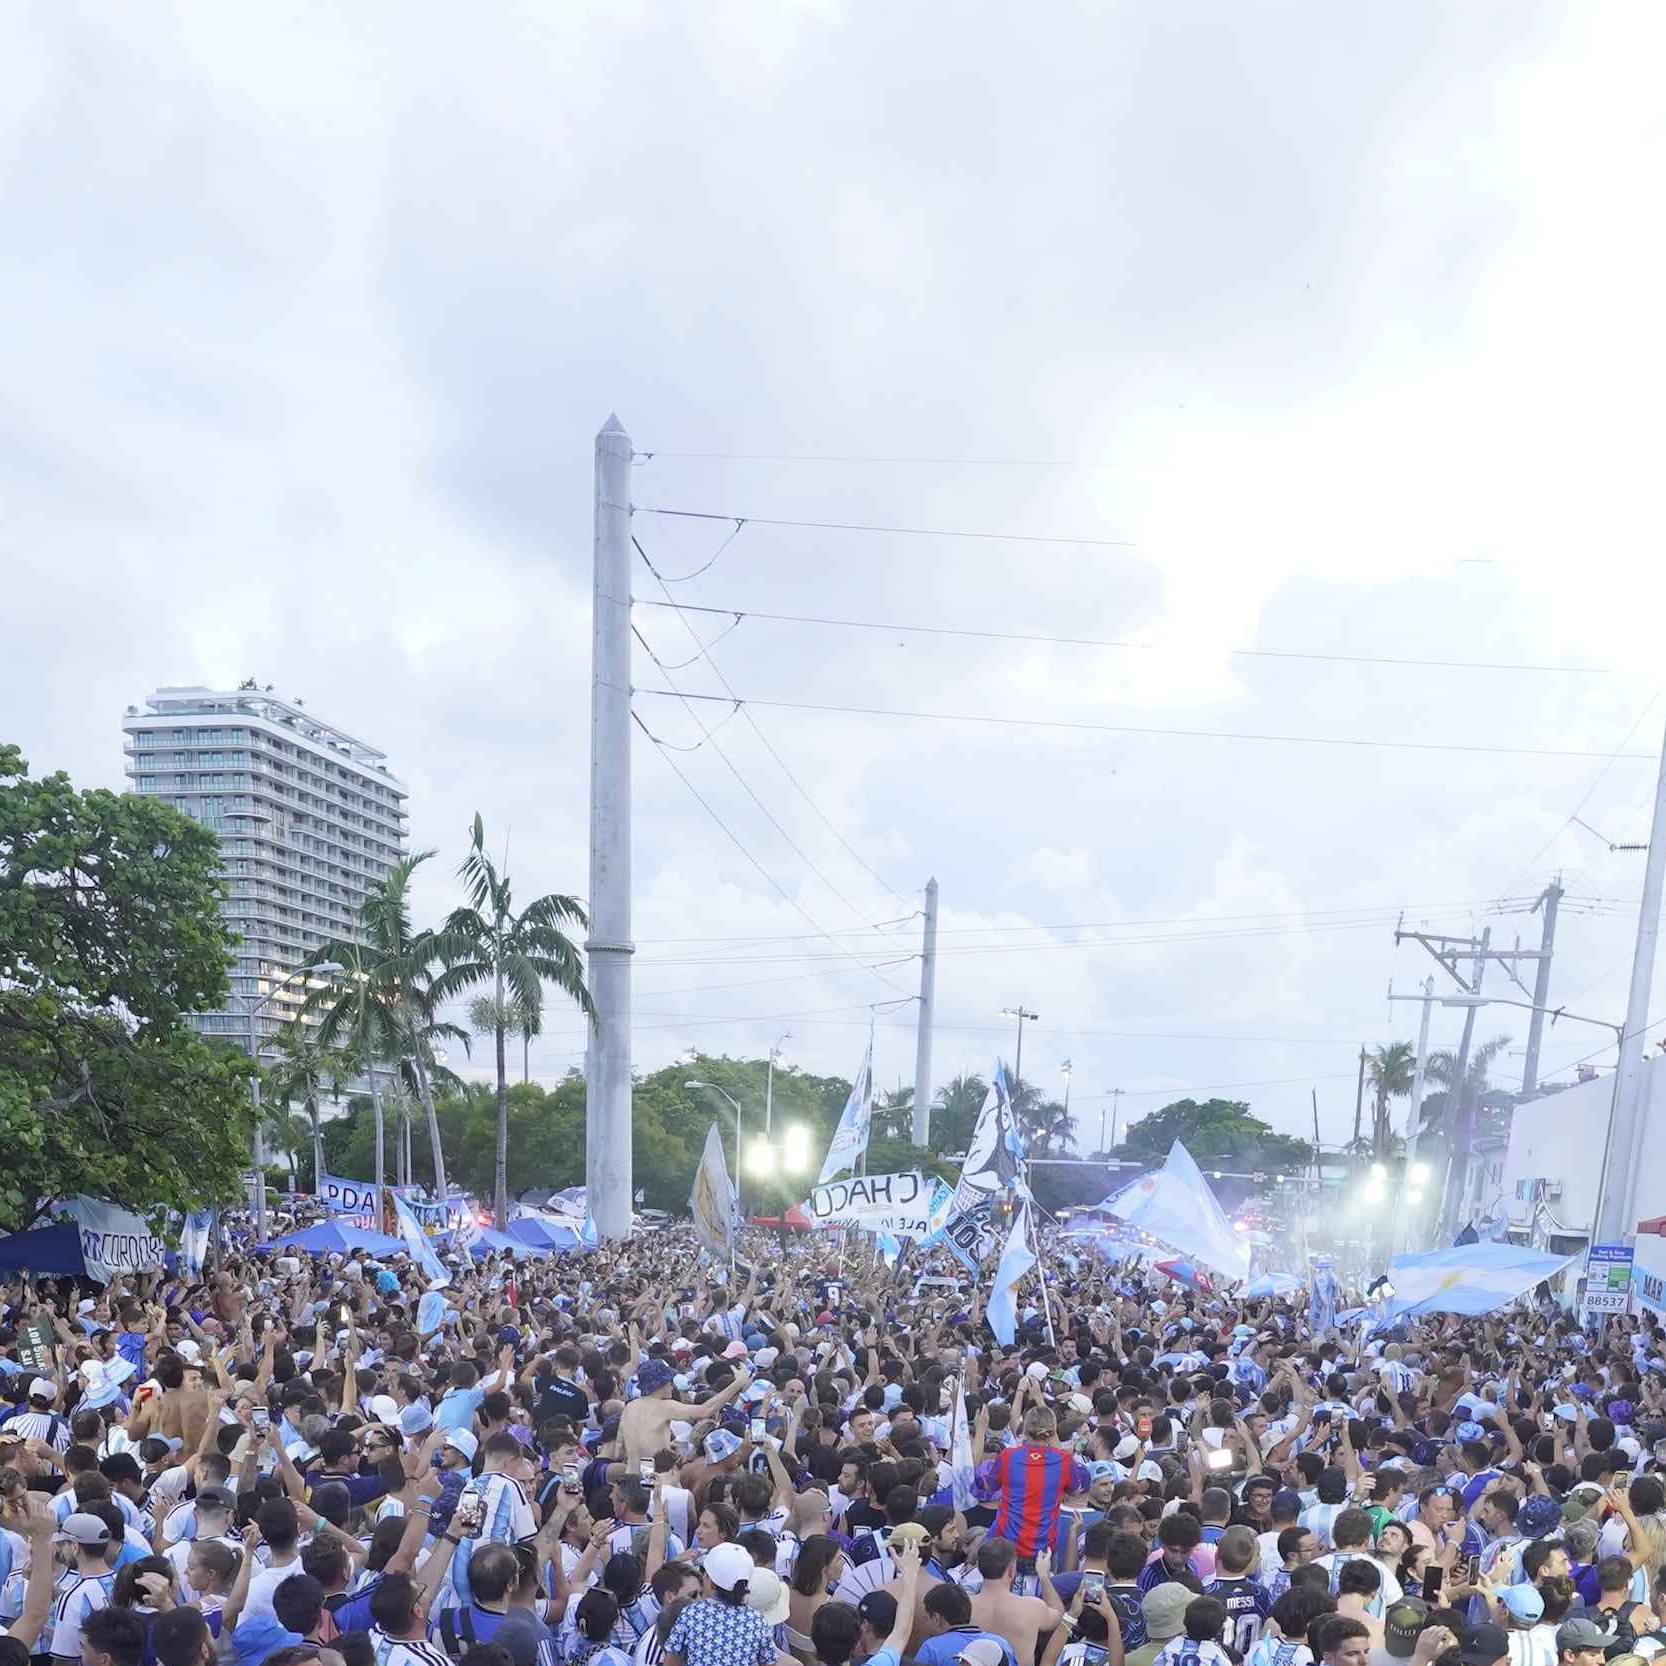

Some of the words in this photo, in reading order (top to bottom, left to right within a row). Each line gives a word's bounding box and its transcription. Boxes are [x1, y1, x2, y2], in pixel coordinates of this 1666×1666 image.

[1642, 1274, 1664, 1303] MAR
[1586, 1295, 1625, 1308] 88537
[1226, 1595, 1256, 1610] MESSI
